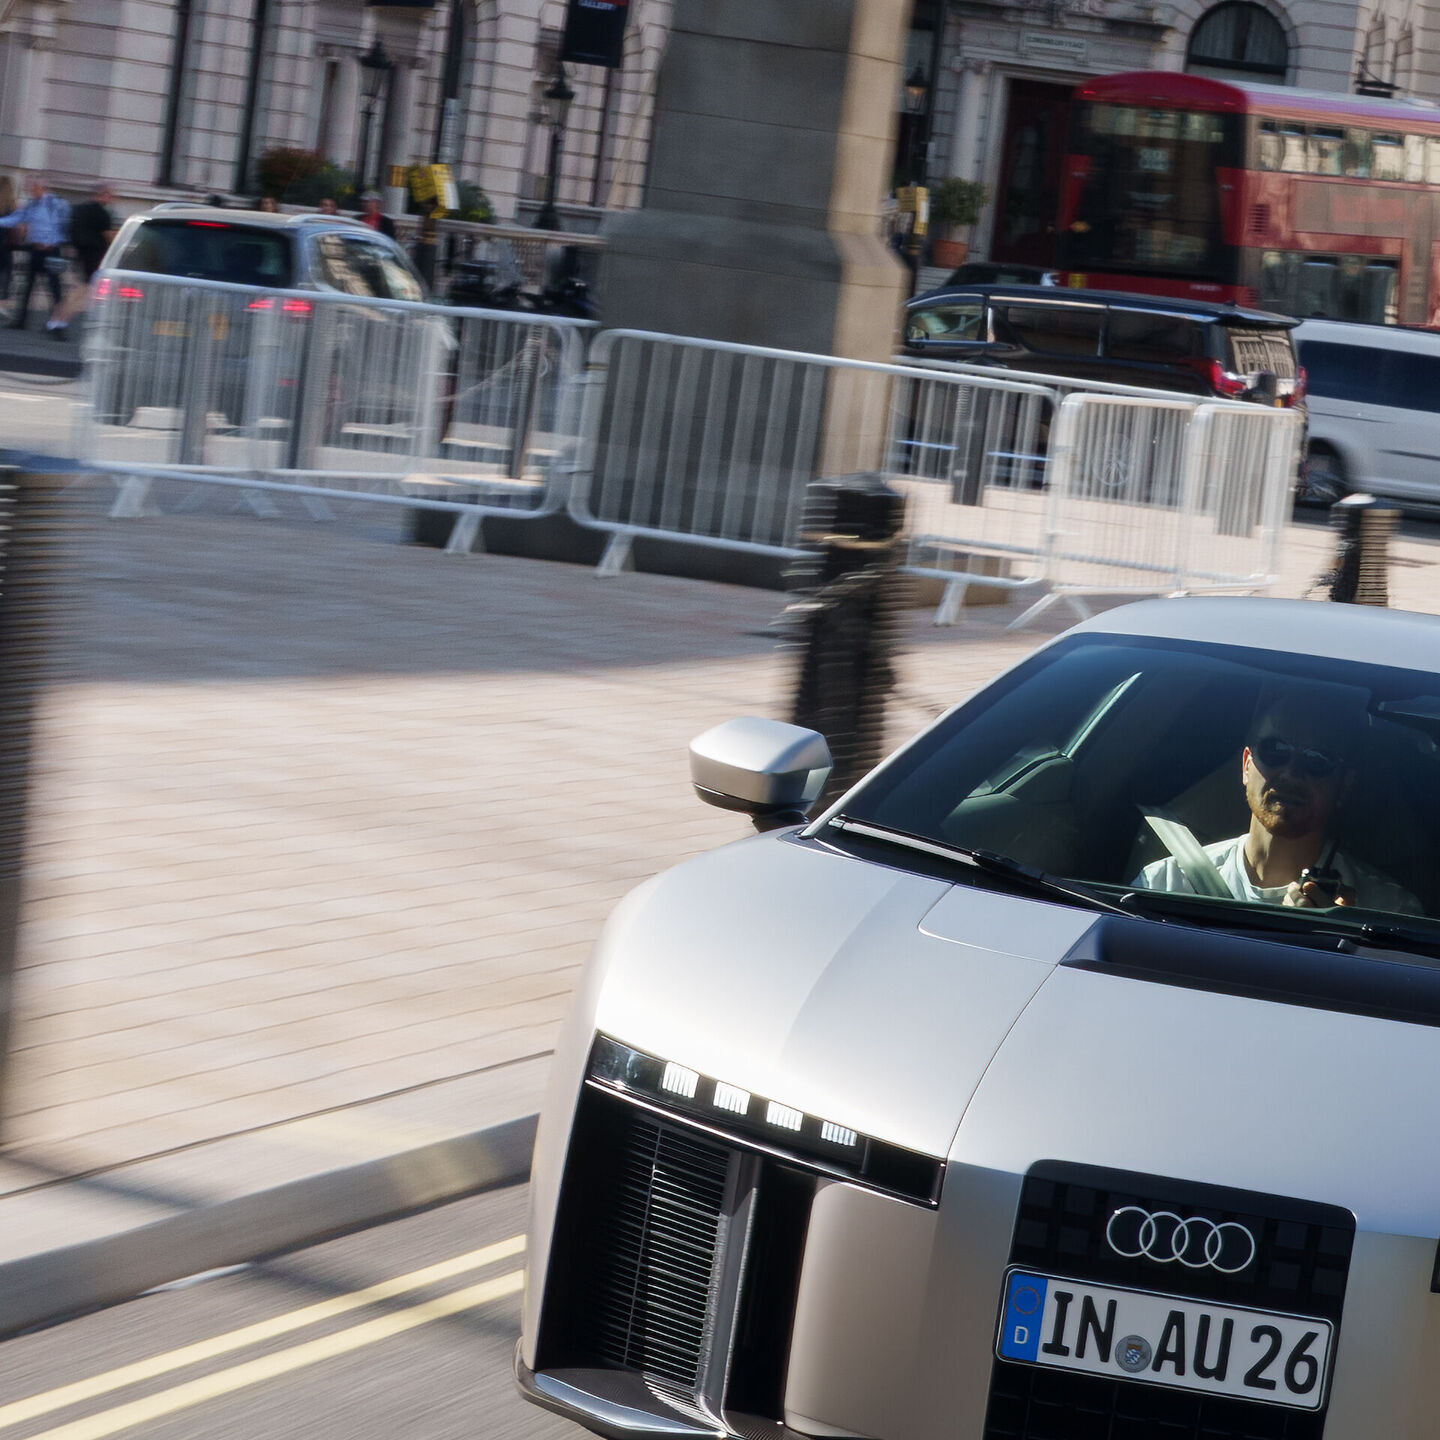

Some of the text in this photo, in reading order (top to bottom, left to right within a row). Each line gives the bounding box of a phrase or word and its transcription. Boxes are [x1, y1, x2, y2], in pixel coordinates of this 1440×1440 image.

[1014, 1326, 1028, 1344] D
[1042, 1291, 1319, 1394] IN AU 26
